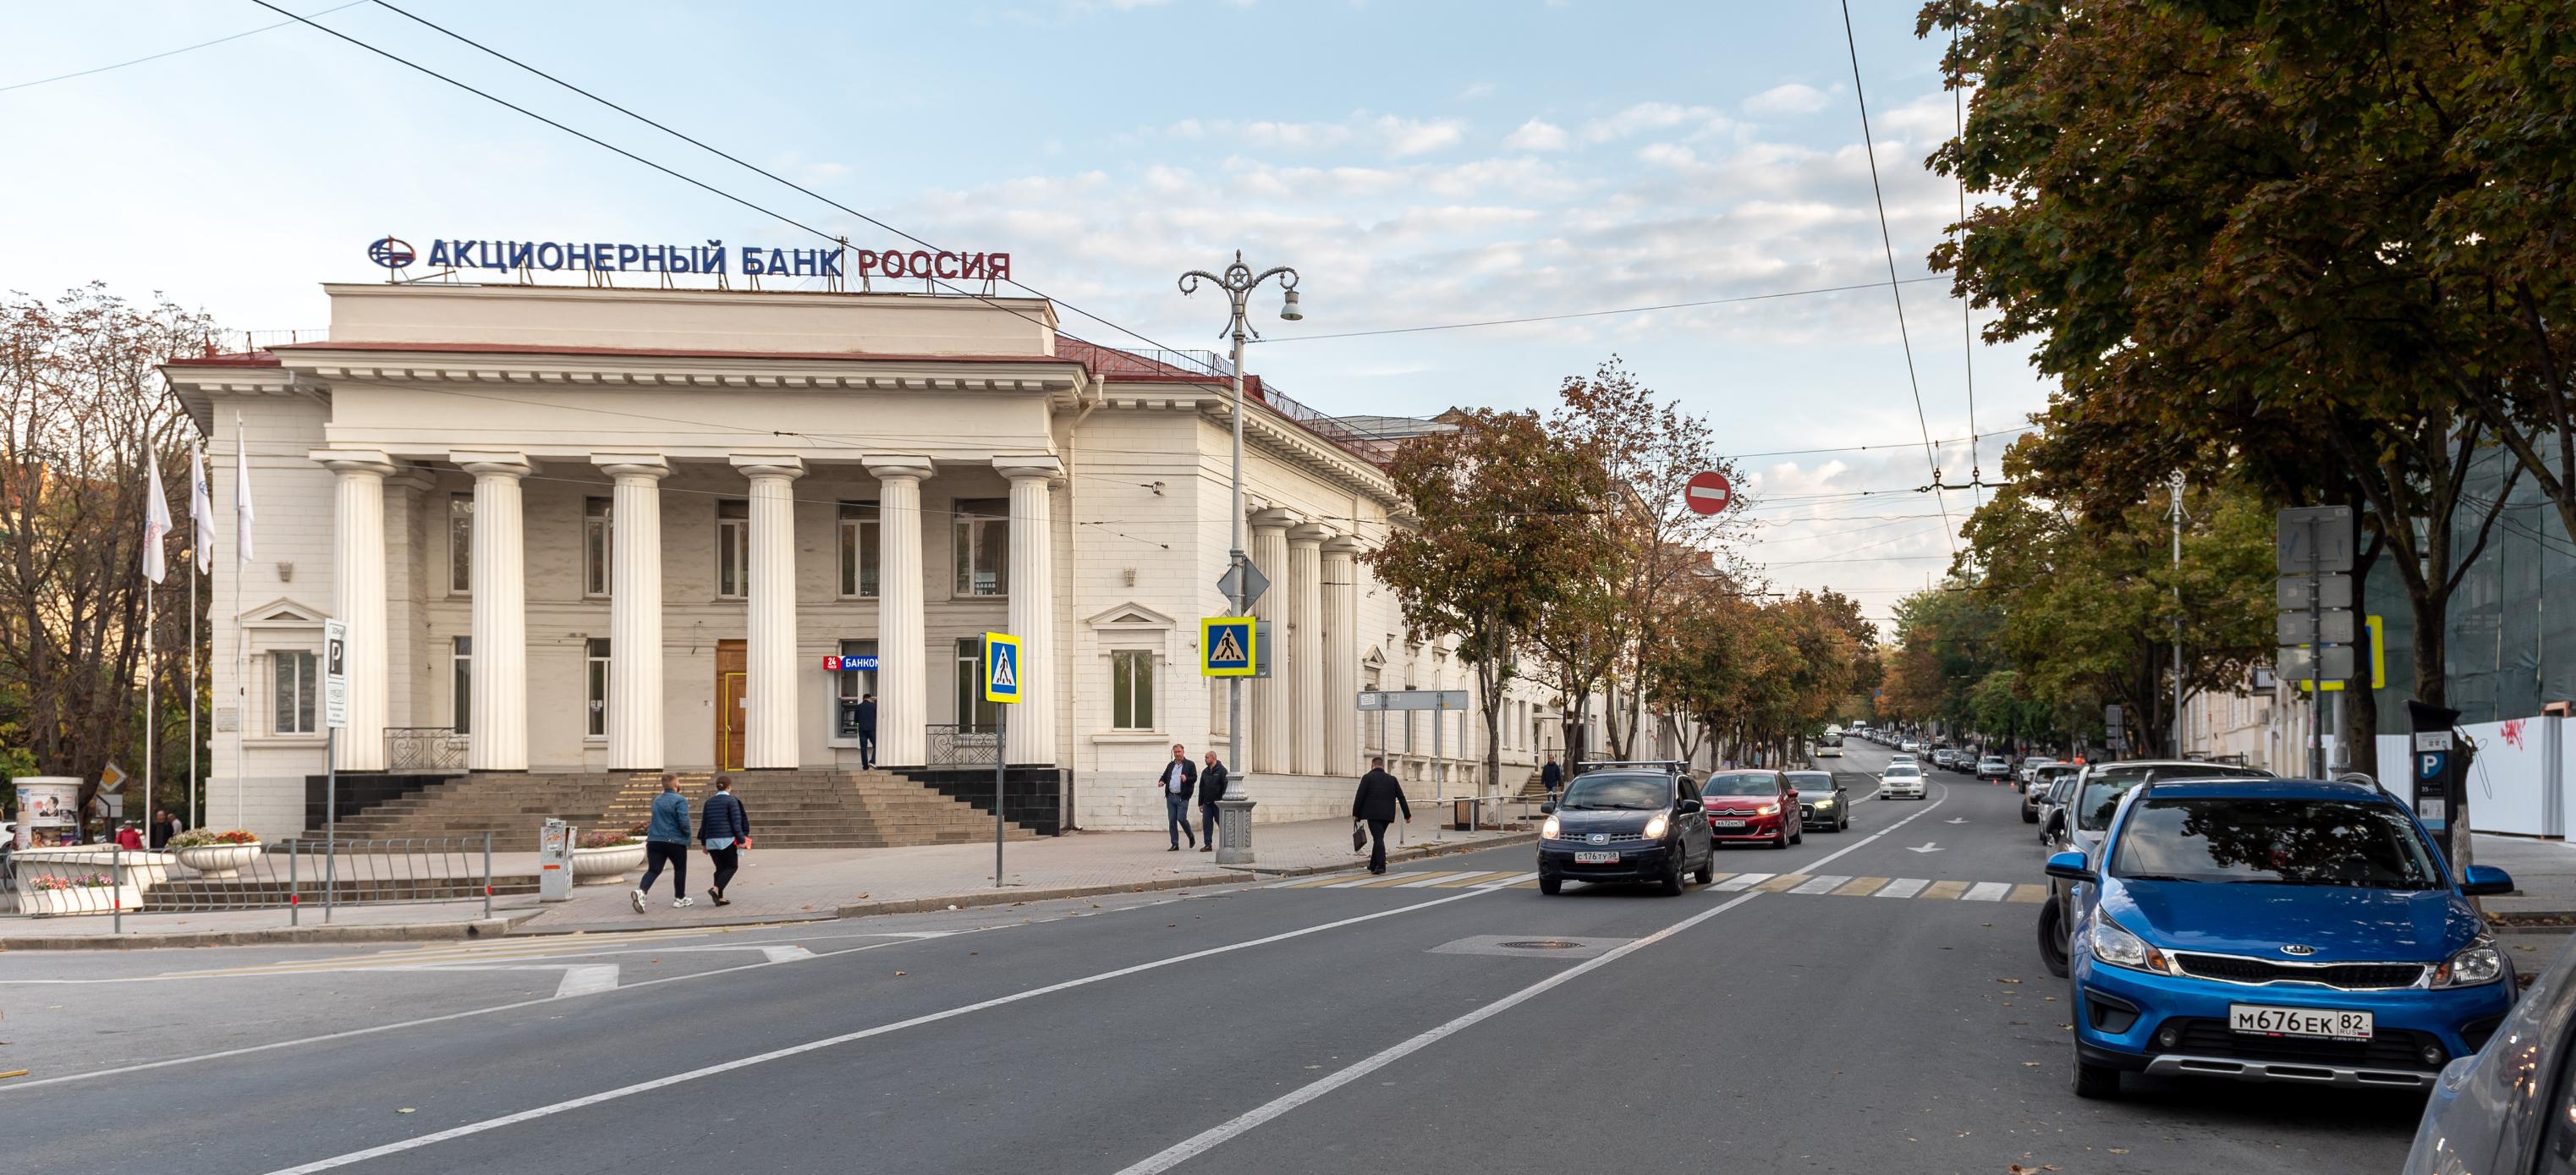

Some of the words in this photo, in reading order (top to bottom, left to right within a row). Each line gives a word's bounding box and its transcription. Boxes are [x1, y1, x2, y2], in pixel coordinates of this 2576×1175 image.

[427, 239, 727, 275] АКЦИОНЕРНЫЙ
[742, 247, 843, 277] БАНК
[858, 250, 1010, 281] РОССИЯ
[331, 641, 342, 671] P
[2423, 755, 2437, 774] P
[2239, 1010, 2333, 1034] М676ЕК
[2341, 1014, 2363, 1029] 82
